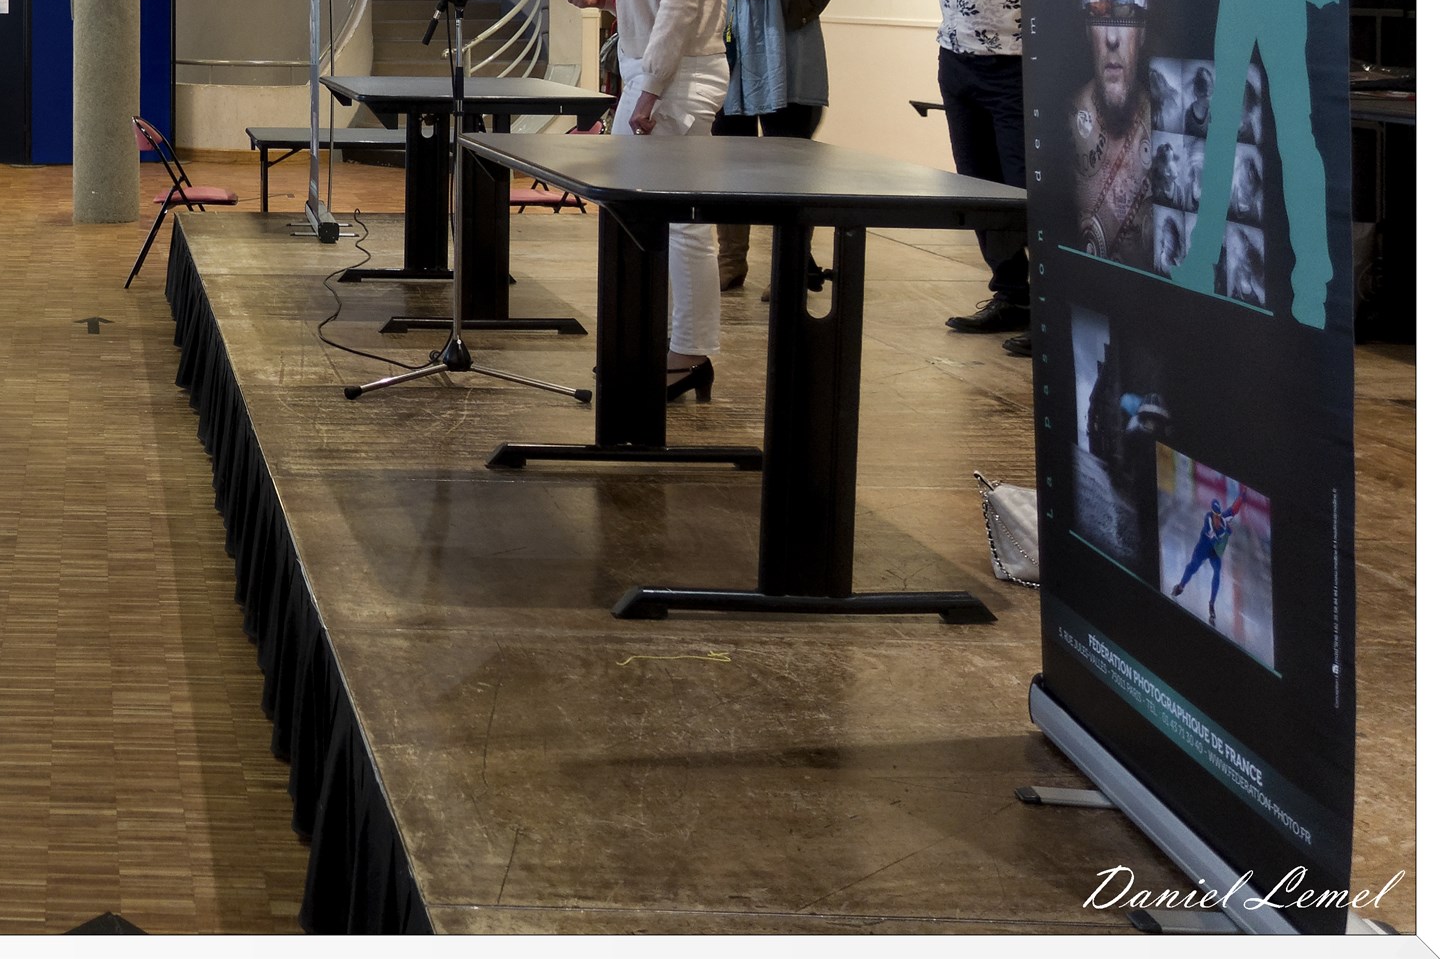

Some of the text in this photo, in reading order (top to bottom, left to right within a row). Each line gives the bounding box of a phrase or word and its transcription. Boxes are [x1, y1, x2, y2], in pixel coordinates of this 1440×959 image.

[1088, 633, 1264, 787] FÉDÉRATION PHOTOGRAPHIQUE DE FRANCE
